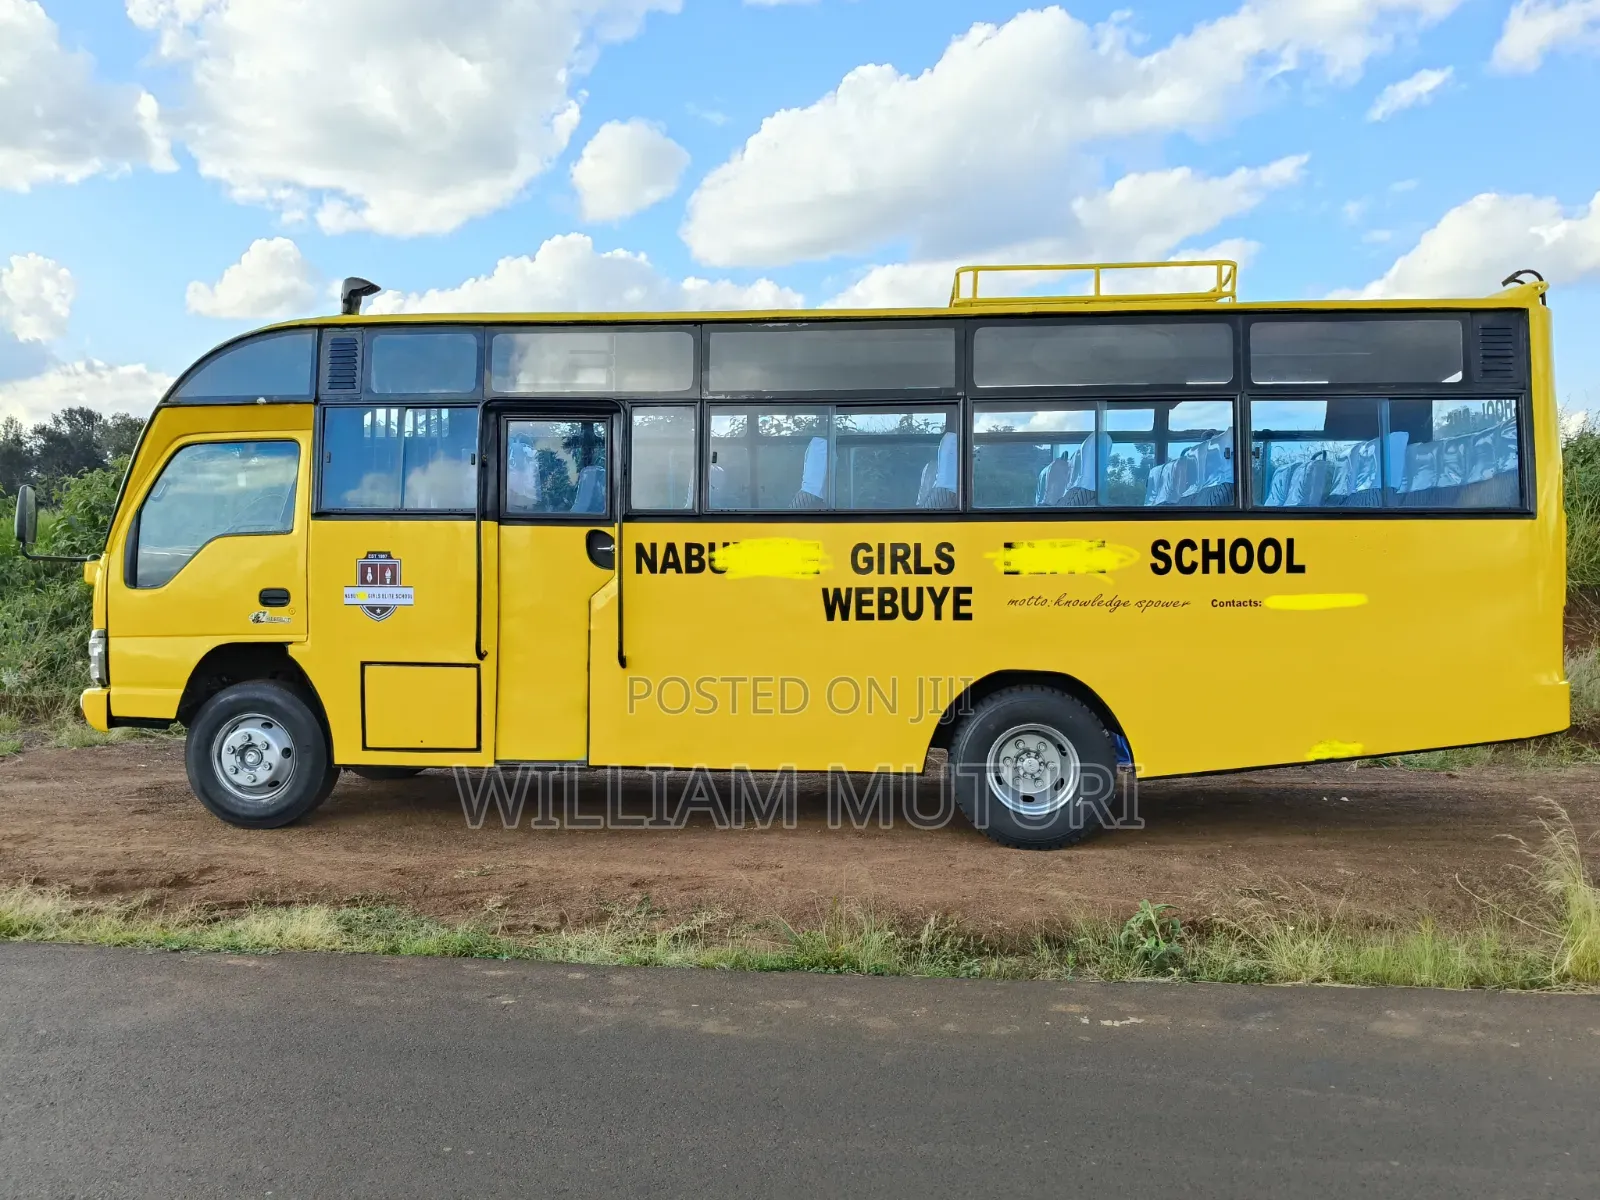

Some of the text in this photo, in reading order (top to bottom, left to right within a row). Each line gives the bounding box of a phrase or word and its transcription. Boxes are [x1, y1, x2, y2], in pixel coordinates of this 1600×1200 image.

[850, 541, 956, 575] GIRLS
[1150, 537, 1306, 576] SCHOOL
[395, 592, 413, 600] SCHOOL
[821, 586, 973, 622] WEBUYE
[1211, 598, 1262, 608] Contacts:
